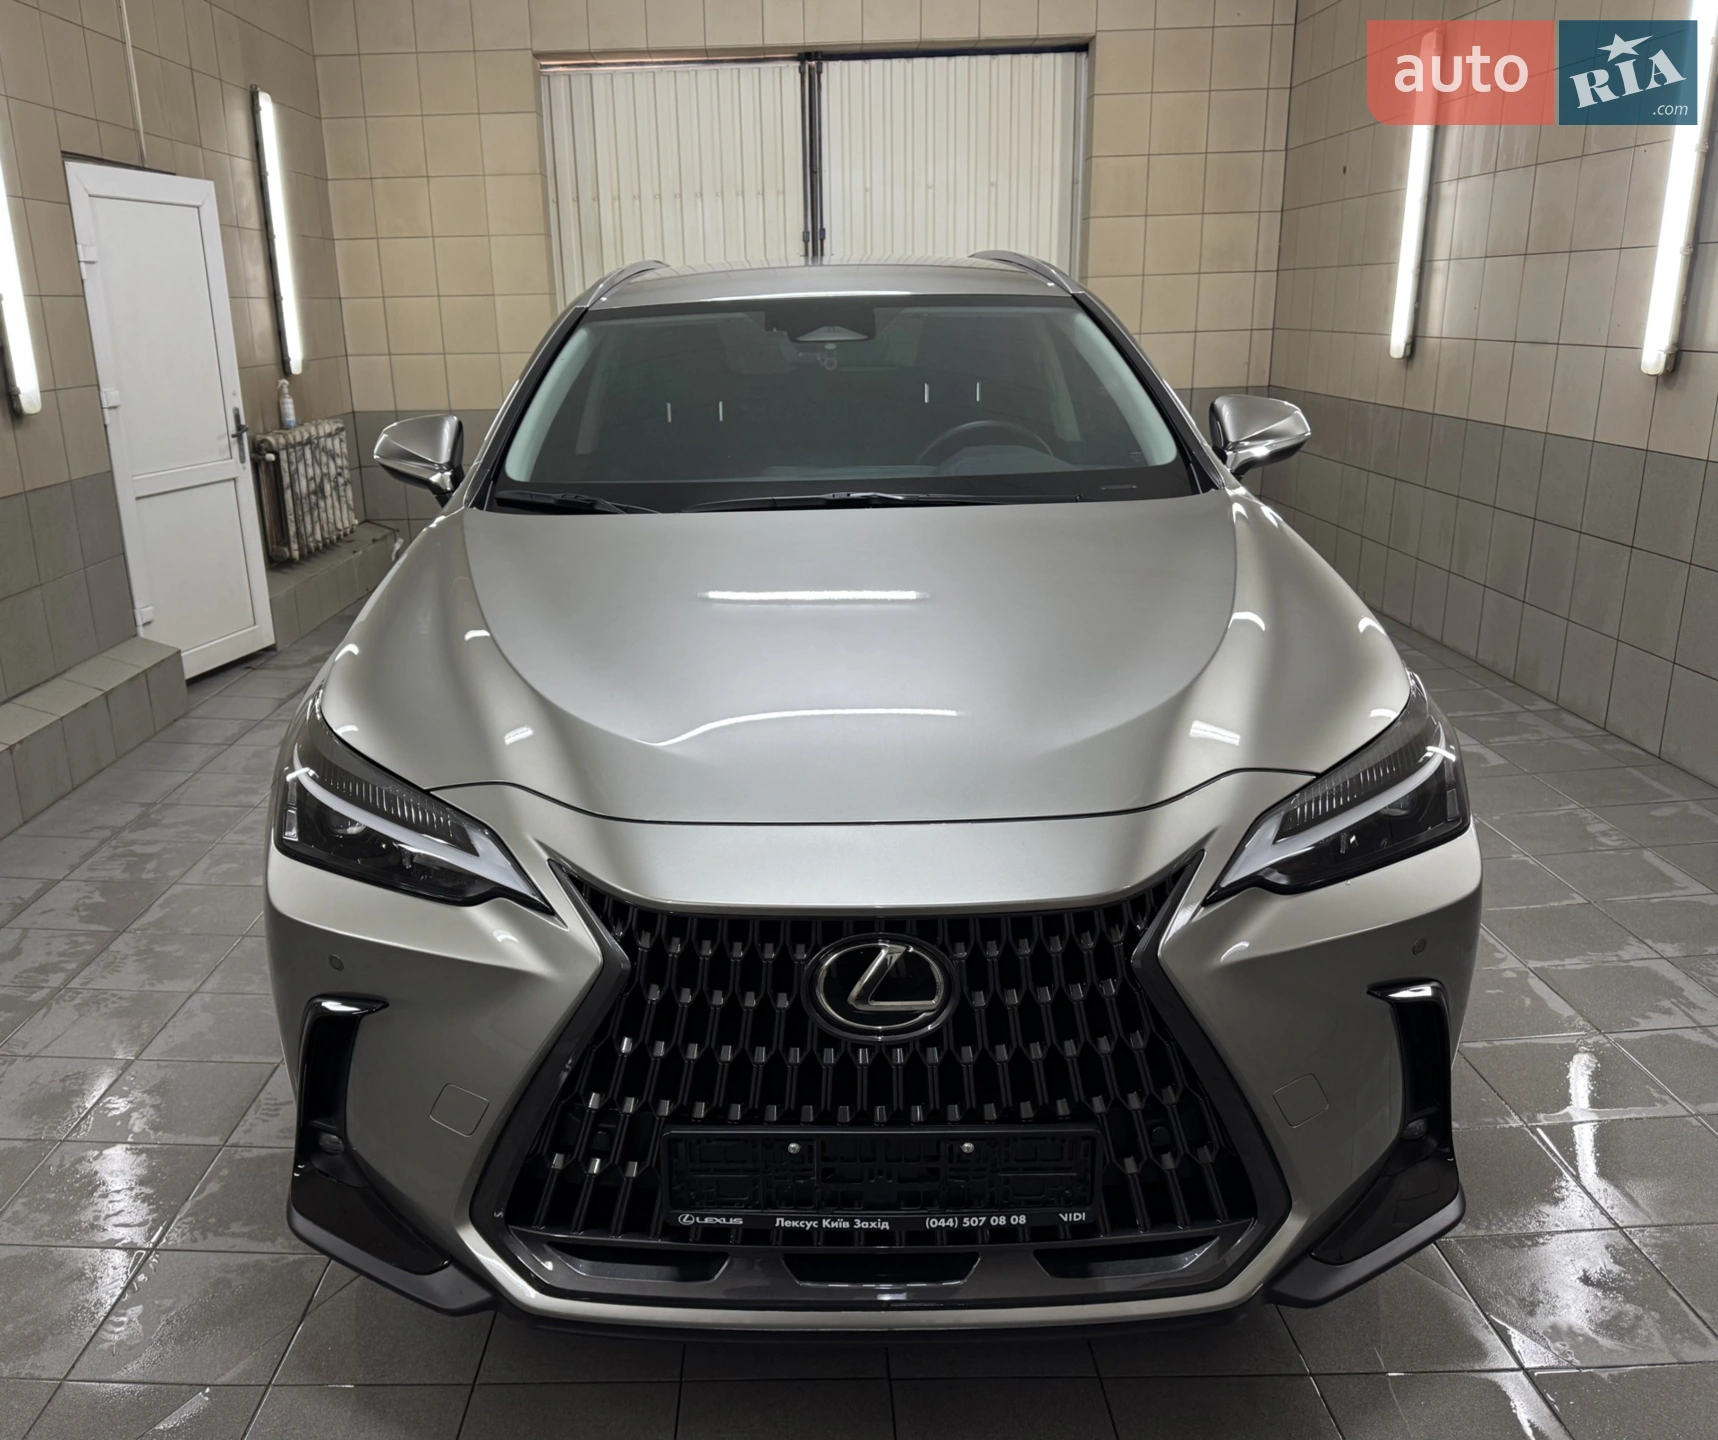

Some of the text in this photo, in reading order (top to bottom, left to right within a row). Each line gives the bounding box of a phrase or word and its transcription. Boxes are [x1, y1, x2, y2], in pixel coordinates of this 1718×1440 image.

[695, 1216, 744, 1226] LEXUS
[925, 1214, 1027, 1229] (044) 507 08 08
[1058, 1212, 1086, 1222] VIDI
[774, 1216, 890, 1231] Лексус Київ Захід
